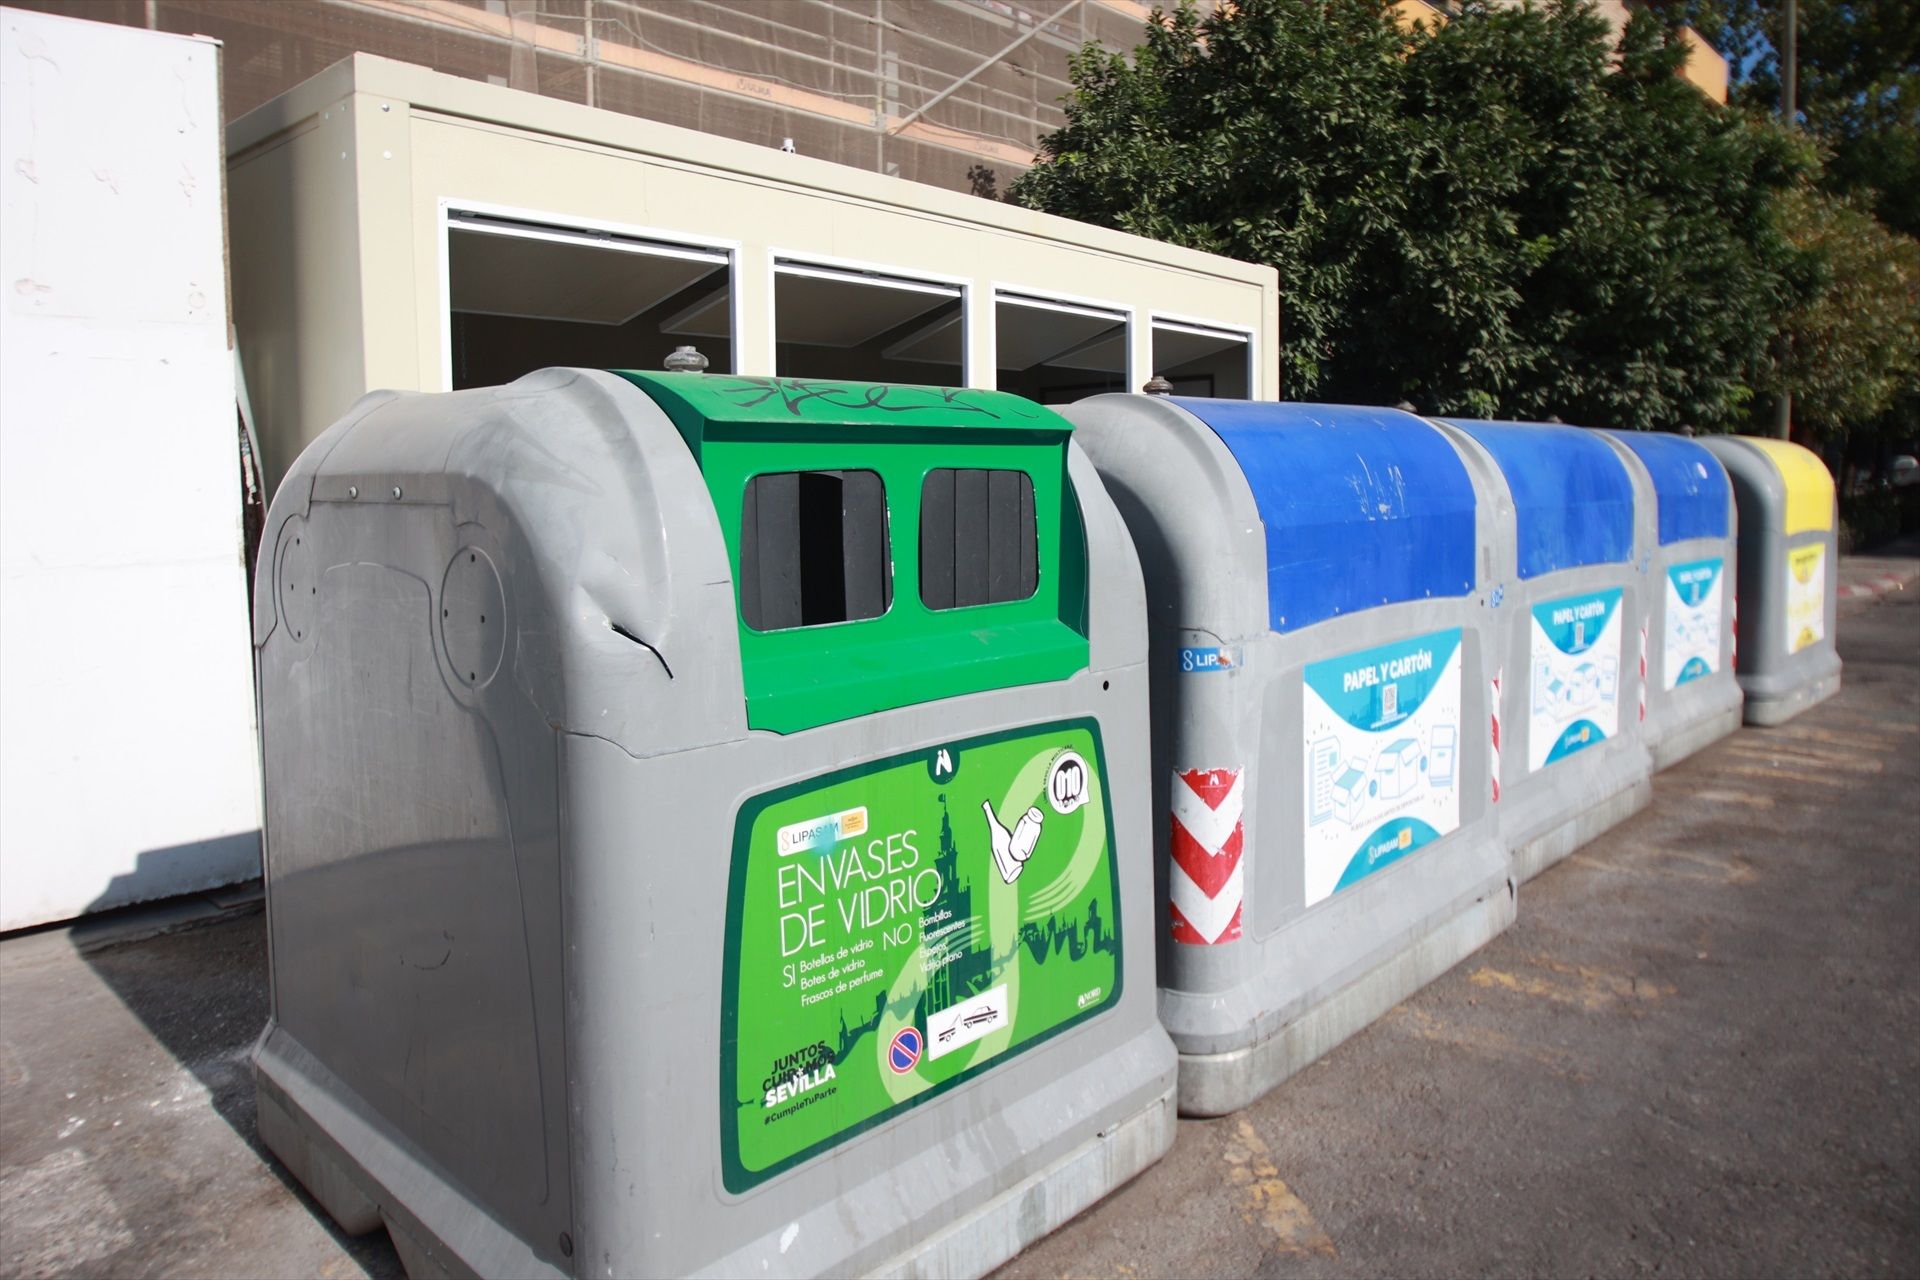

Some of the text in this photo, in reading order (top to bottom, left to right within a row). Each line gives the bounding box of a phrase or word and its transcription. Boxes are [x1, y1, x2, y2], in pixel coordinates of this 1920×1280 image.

[1343, 649, 1432, 692] PAPEL Y CARTÓN
[778, 830, 919, 909] ENVASES
[780, 868, 942, 957] DE VIDRIO
[919, 909, 953, 928] Bombillas
[883, 923, 913, 950] NO
[919, 920, 966, 943] Fluorescentes
[800, 939, 874, 973] Botellas de vidrio
[942, 951, 963, 968] plano
[783, 963, 796, 988] SI
[800, 959, 866, 990] Botes de vidrio
[801, 968, 884, 1007] Frascos de perfume
[772, 1040, 825, 1075] JUNTOS
[765, 1063, 836, 1108] SEVILLA
[764, 1087, 837, 1125] #CumpleTuParte
